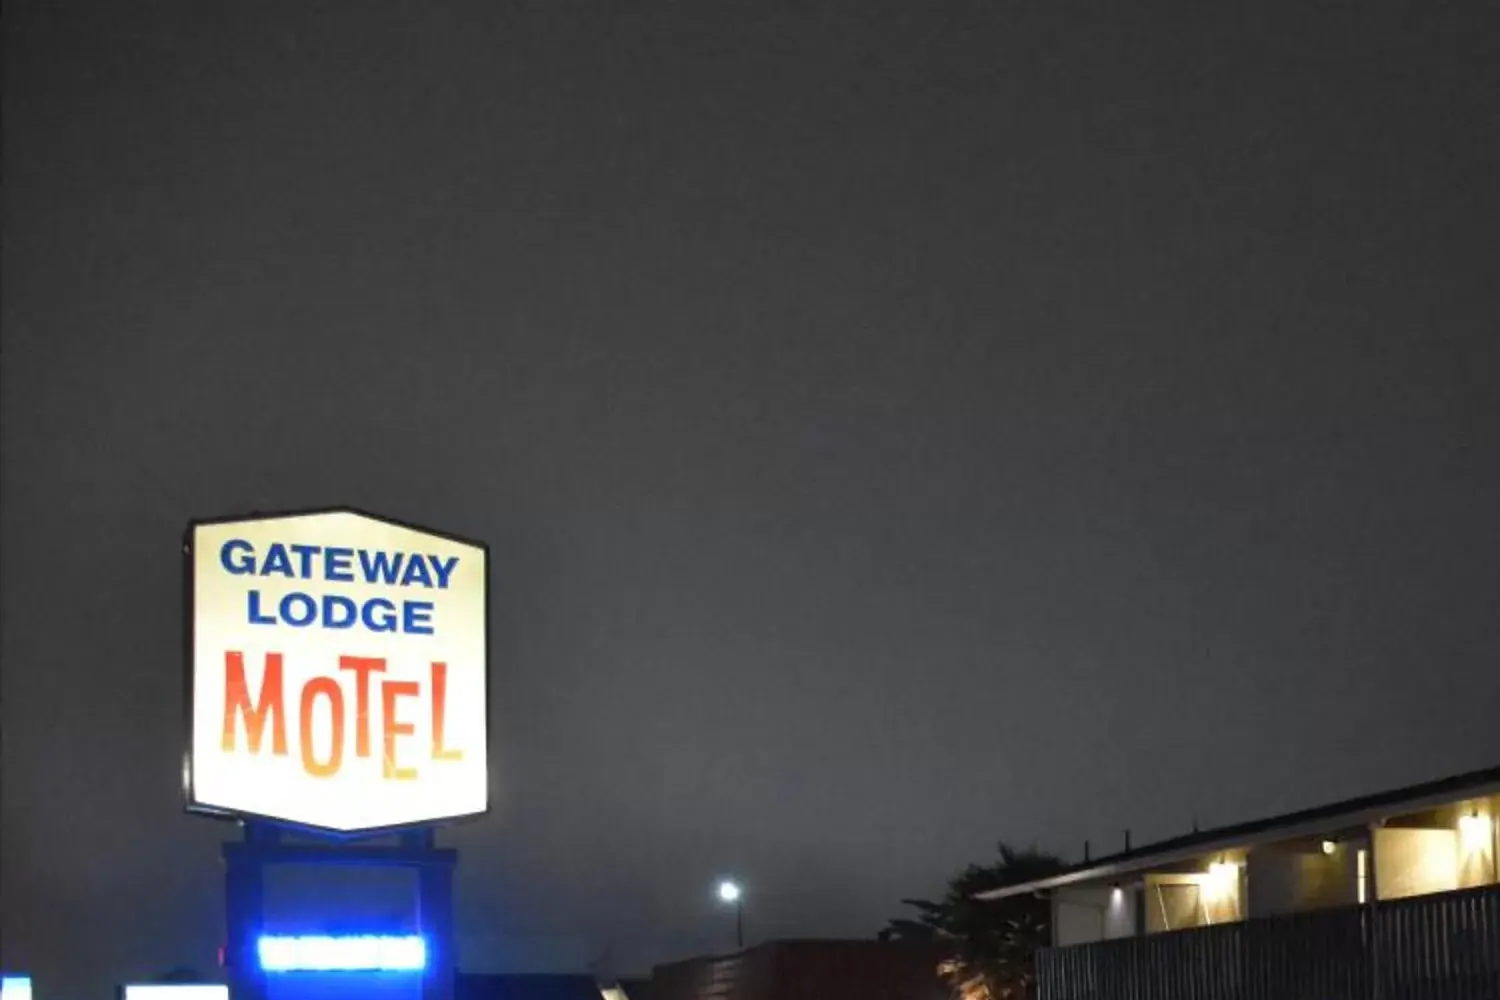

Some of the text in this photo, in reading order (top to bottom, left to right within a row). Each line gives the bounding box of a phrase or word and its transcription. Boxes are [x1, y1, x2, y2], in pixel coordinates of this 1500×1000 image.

[220, 539, 460, 589] GATEWAY
[248, 590, 435, 635] LODGE
[221, 651, 463, 779] MOTEL
